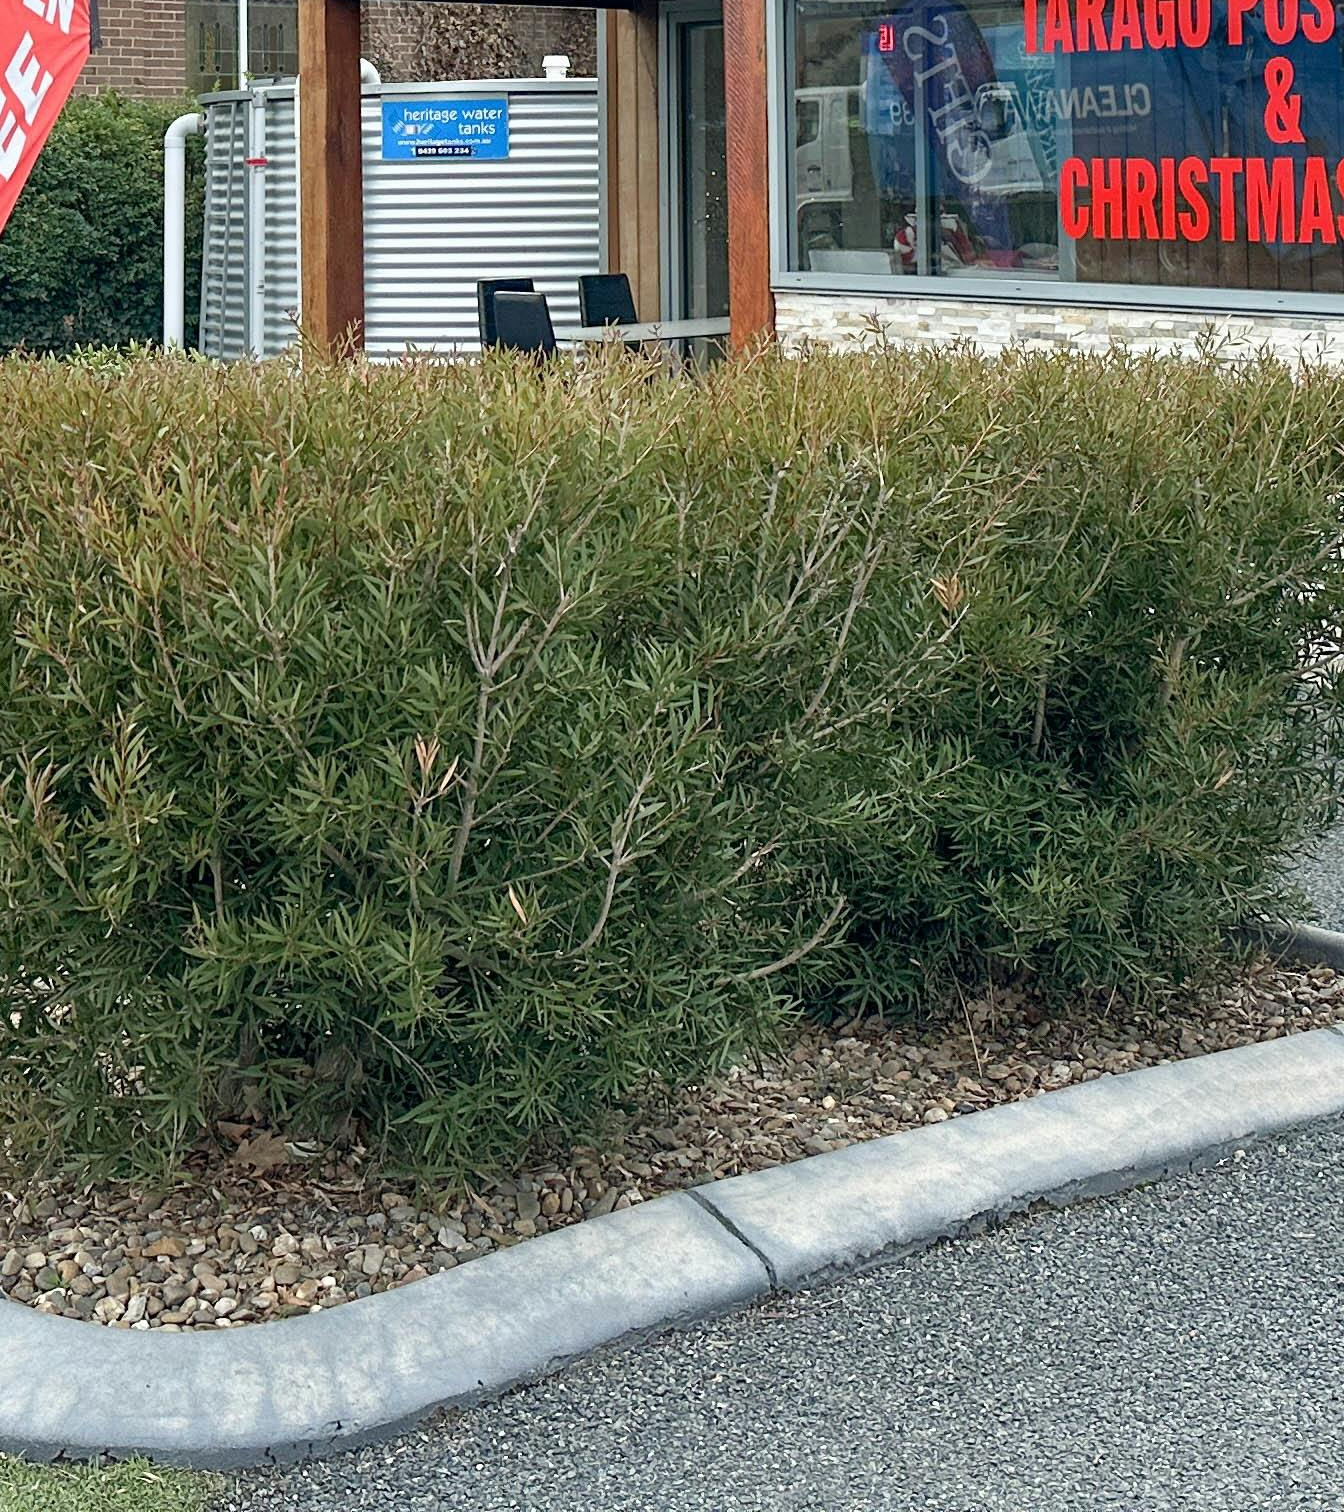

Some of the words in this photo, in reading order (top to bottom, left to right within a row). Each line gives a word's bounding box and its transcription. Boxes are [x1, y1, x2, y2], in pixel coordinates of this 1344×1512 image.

[1264, 56, 1306, 144] &
[403, 108, 458, 123] heritage
[462, 108, 503, 120] water
[458, 121, 496, 135] tanks
